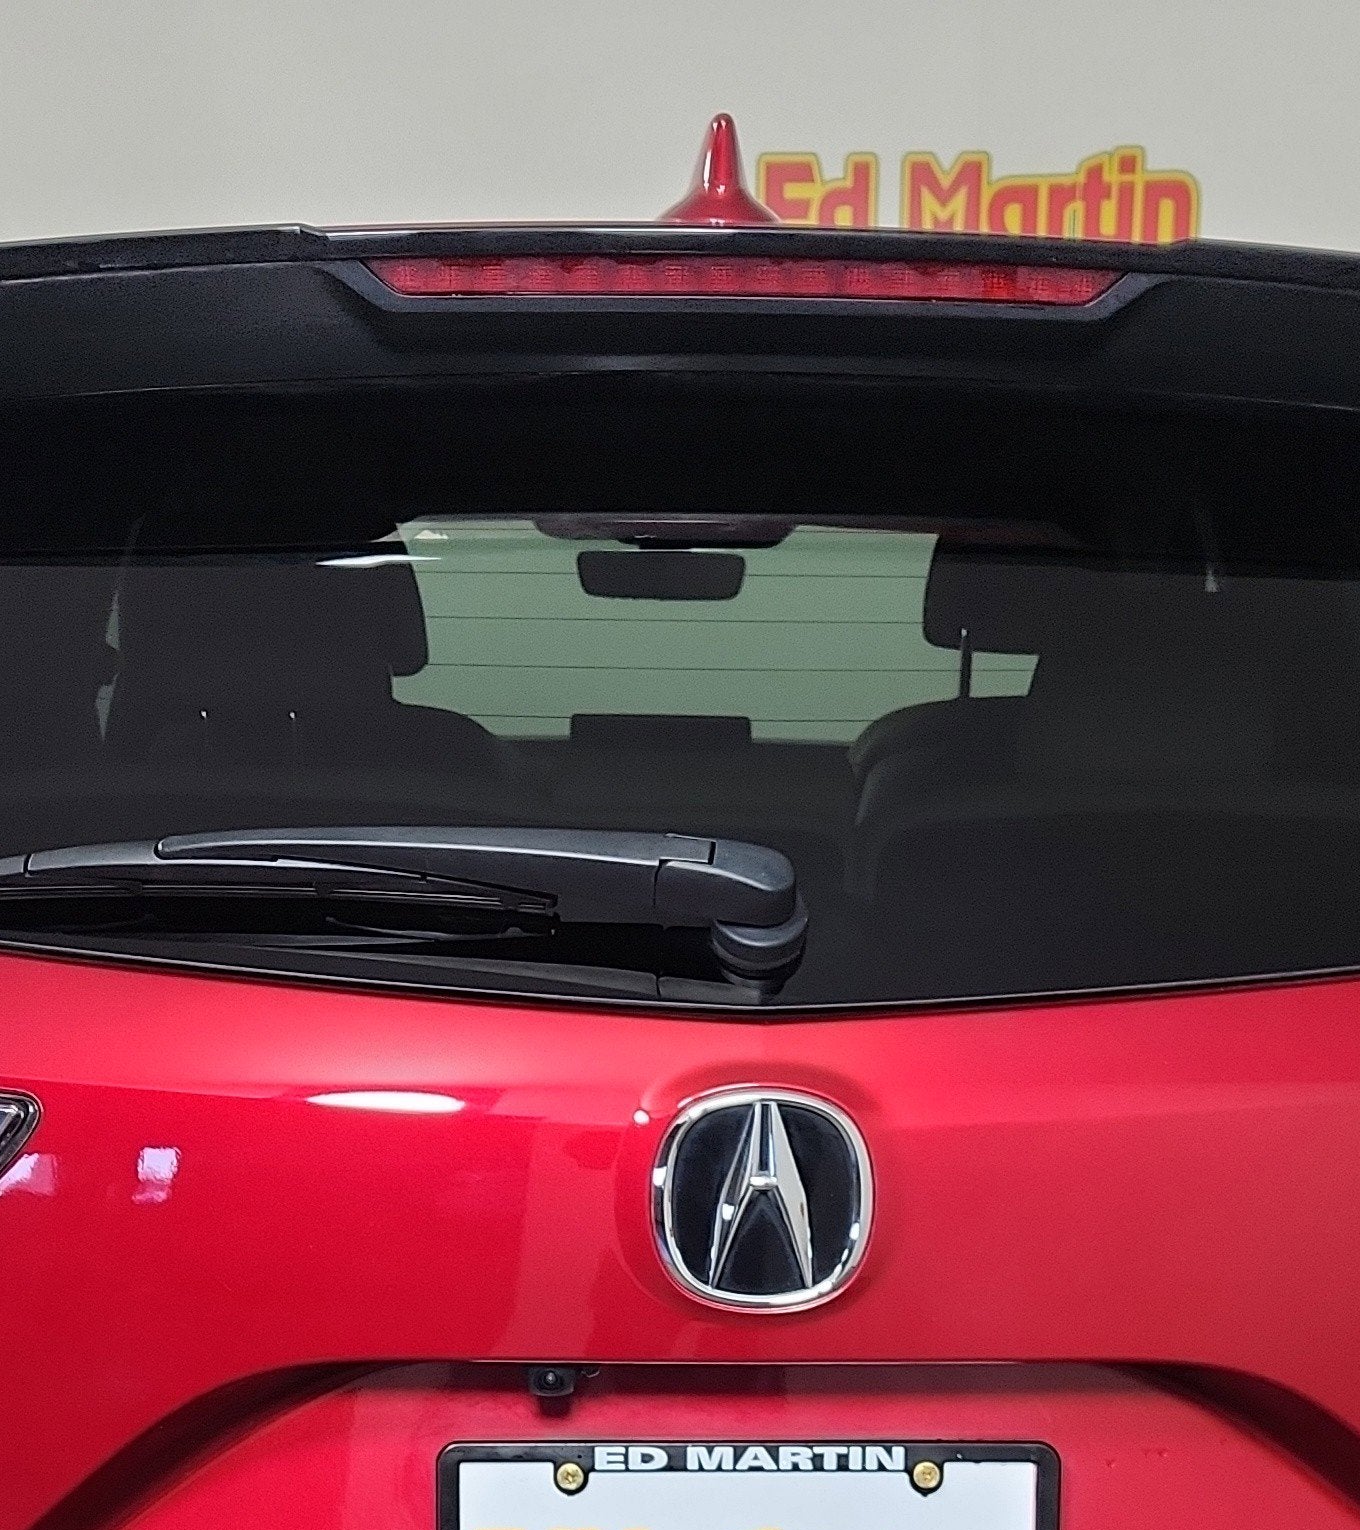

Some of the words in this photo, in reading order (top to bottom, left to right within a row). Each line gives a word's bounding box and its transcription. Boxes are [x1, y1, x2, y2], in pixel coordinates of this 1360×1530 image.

[903, 145, 1198, 243] Martin
[593, 1445, 669, 1472] ED
[685, 1445, 906, 1472] MARTIN
